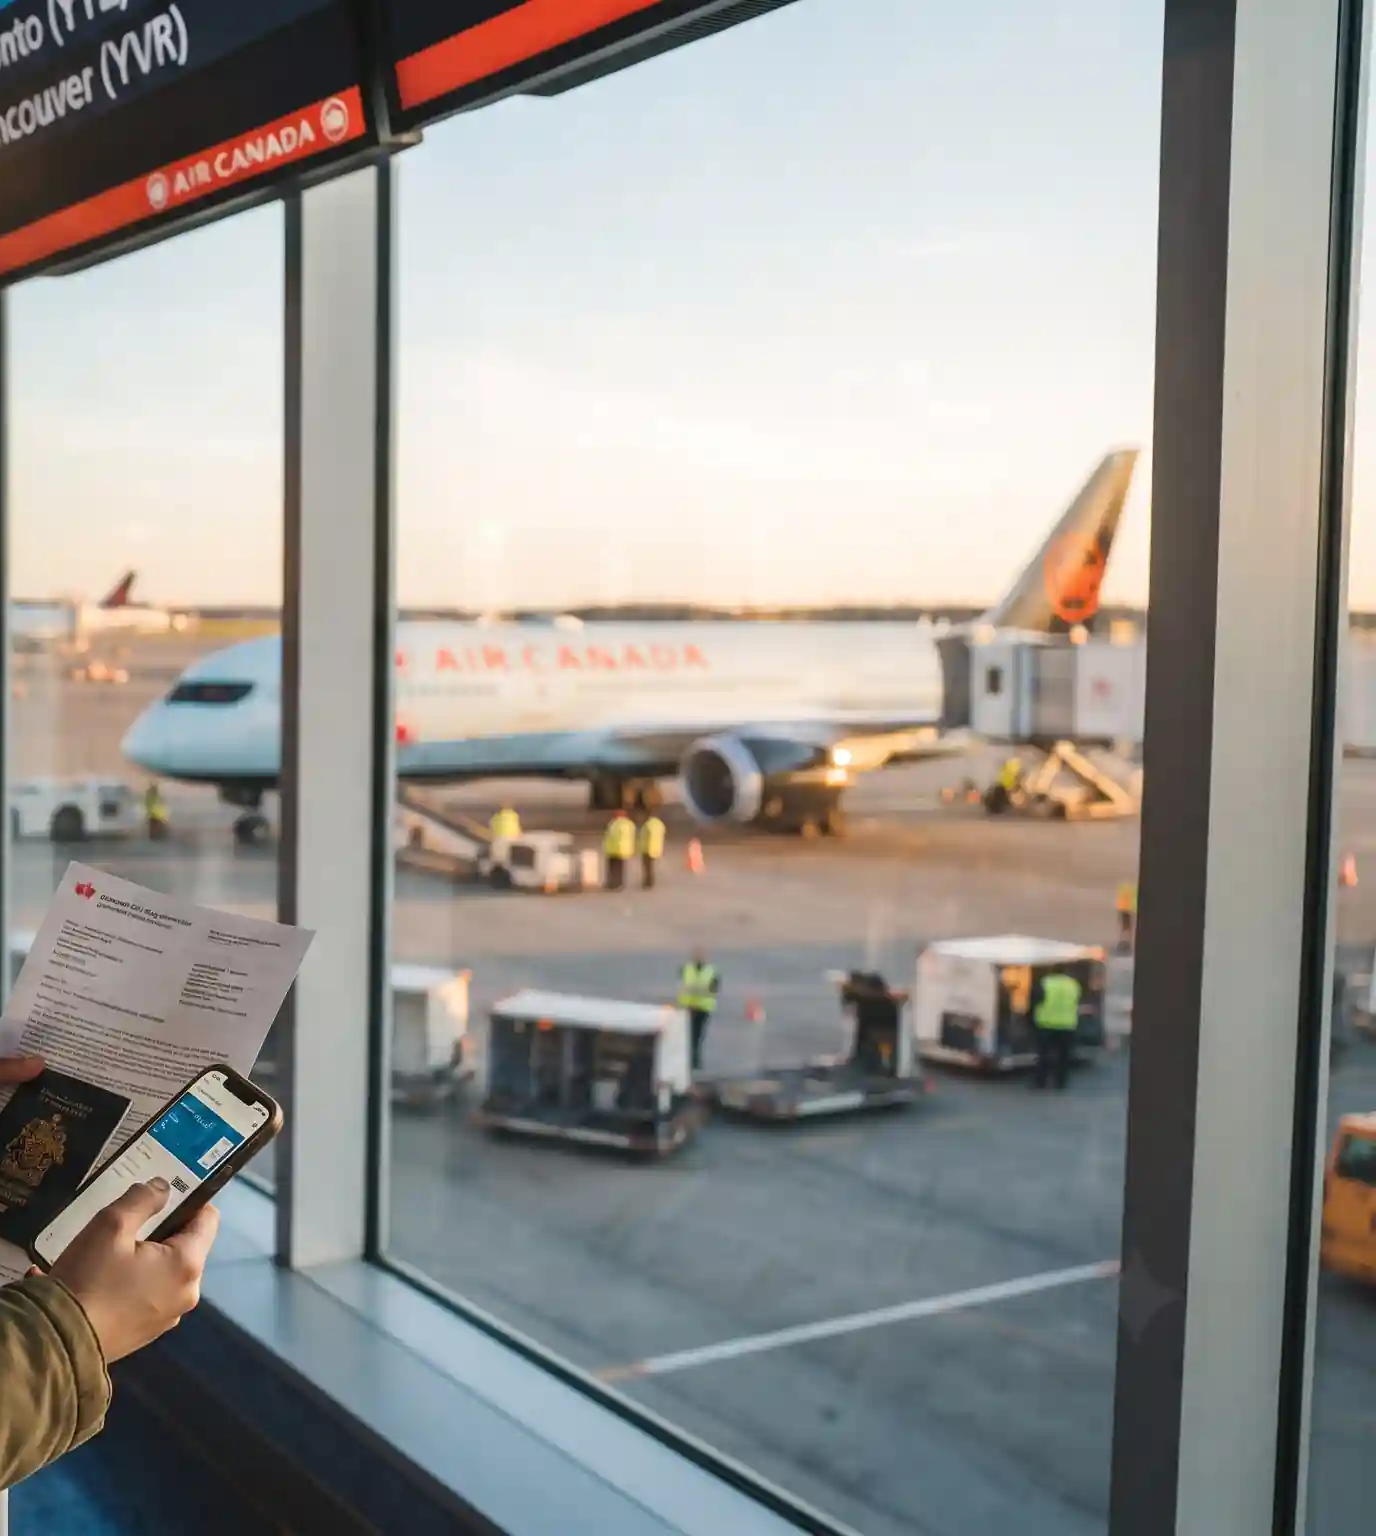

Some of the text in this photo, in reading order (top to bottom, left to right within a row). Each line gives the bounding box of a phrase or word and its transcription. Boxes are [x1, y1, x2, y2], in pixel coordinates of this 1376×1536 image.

[100, 3, 188, 99] (YVR)
[174, 119, 316, 196] AIR CANADA
